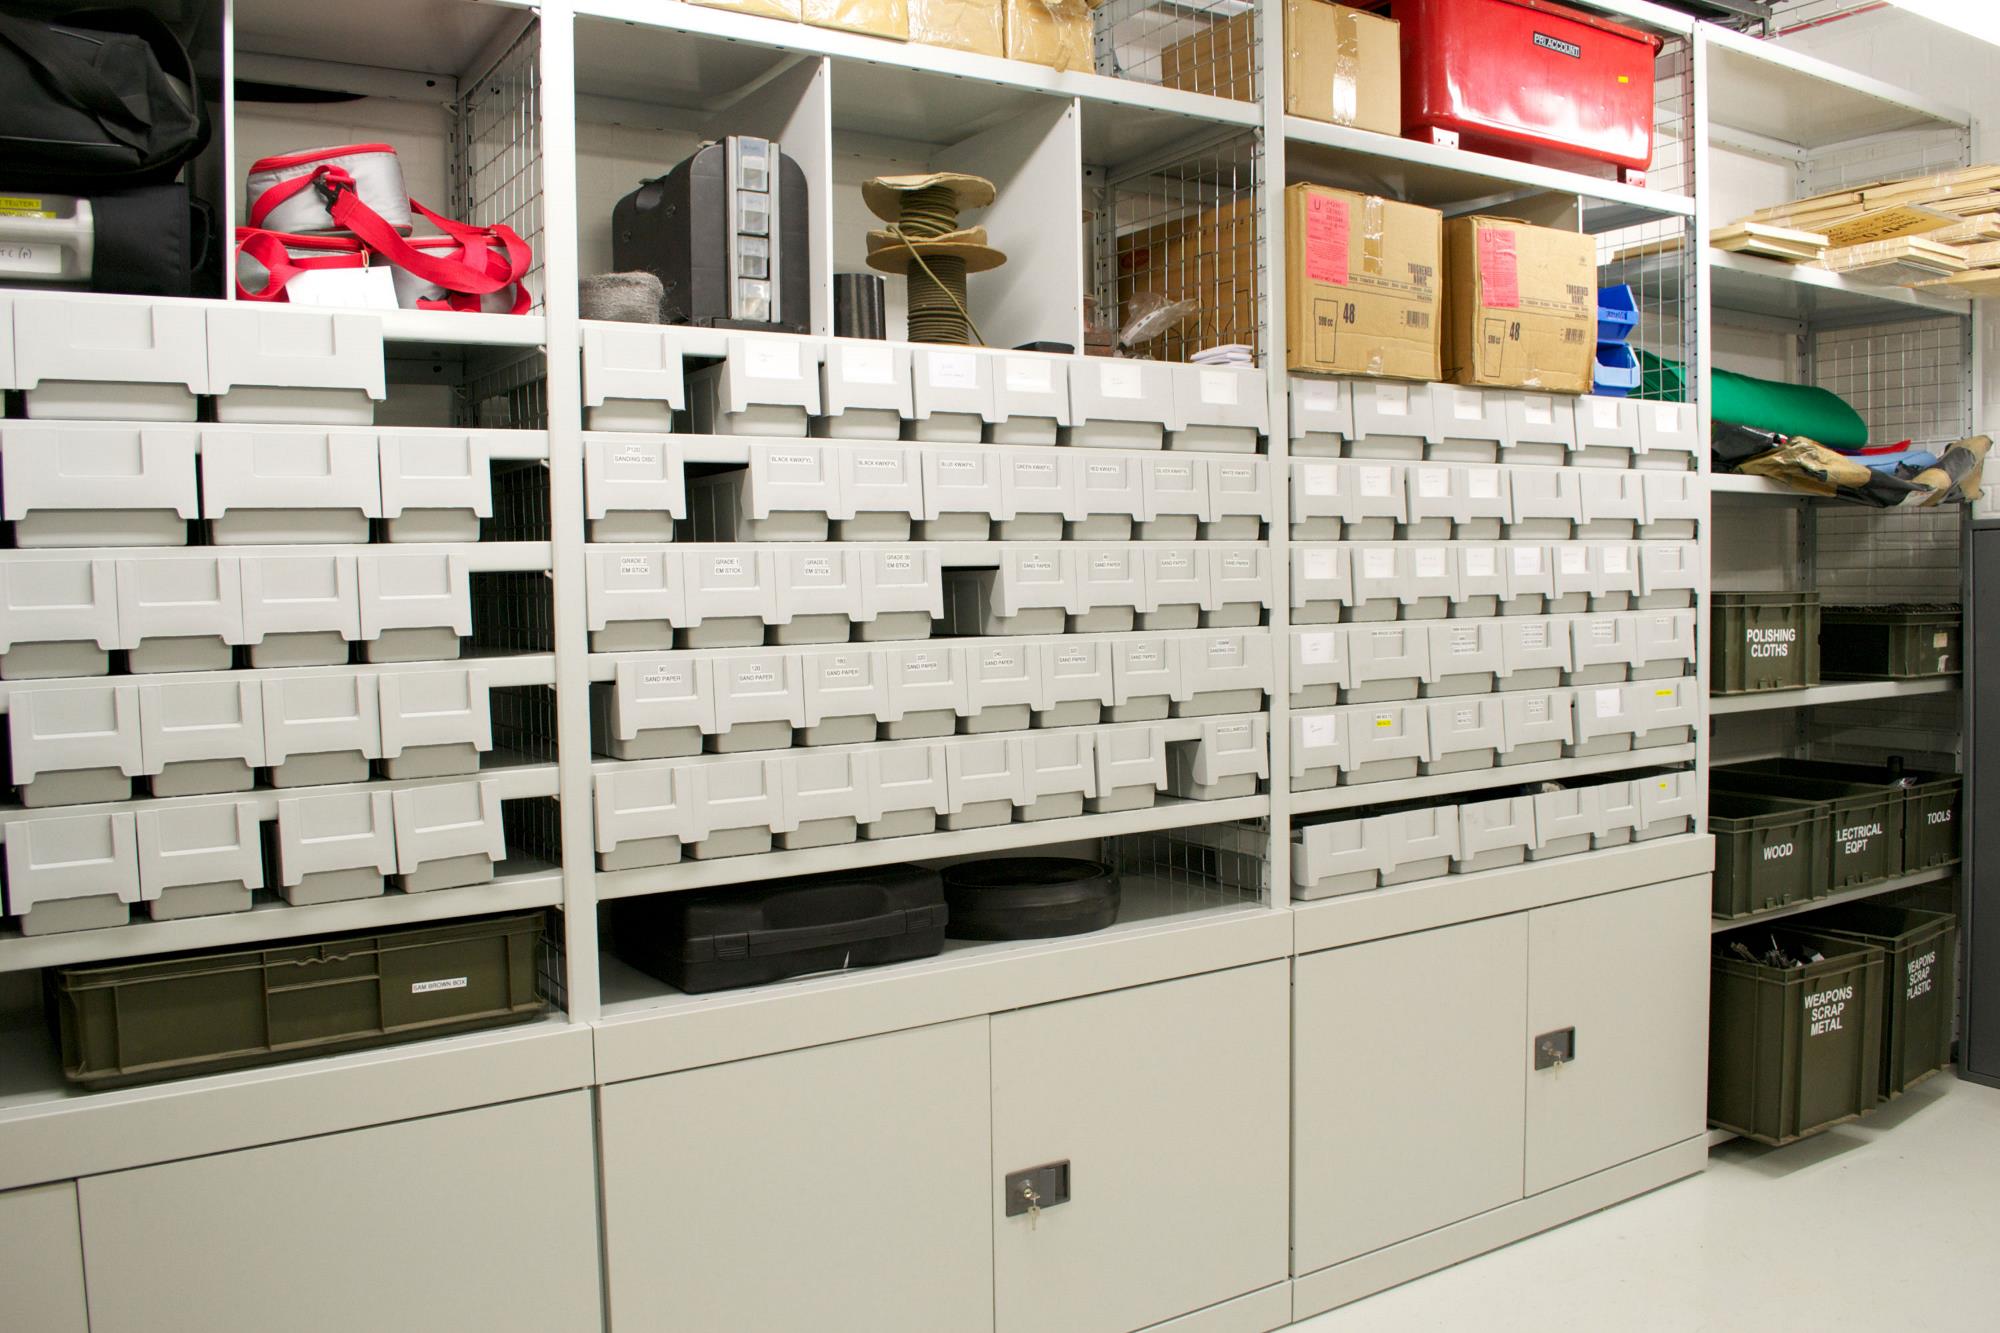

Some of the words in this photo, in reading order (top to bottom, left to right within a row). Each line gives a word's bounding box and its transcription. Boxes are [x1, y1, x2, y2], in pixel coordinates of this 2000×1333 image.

[1548, 39, 1580, 57] ACCOUNT
[1314, 199, 1321, 210] U
[1343, 302, 1355, 324] 48
[1509, 321, 1520, 341] 48
[614, 455, 641, 463] SANDING
[641, 456, 656, 464] DISC
[771, 456, 789, 464] BLACK
[631, 566, 649, 574] STICK
[715, 558, 735, 566] GRADE
[725, 567, 742, 575] STICK
[814, 568, 830, 576] STICK
[1746, 628, 1796, 642] POLISHING
[1751, 643, 1788, 657] CLOTHS
[1927, 809, 1951, 825] TOOLS
[1836, 823, 1883, 842] LECTRICAL
[1763, 842, 1793, 860] WOOD
[1845, 839, 1868, 854] EQPT
[1907, 951, 1936, 974] WEAPONS
[1909, 966, 1930, 986] SCRAP
[428, 981, 452, 989] BROWN
[1906, 979, 1932, 1001] PLASTIC
[1804, 986, 1853, 1009] WEAPONS
[1811, 1002, 1845, 1022] SCRAP
[1810, 1017, 1843, 1037] METAL
